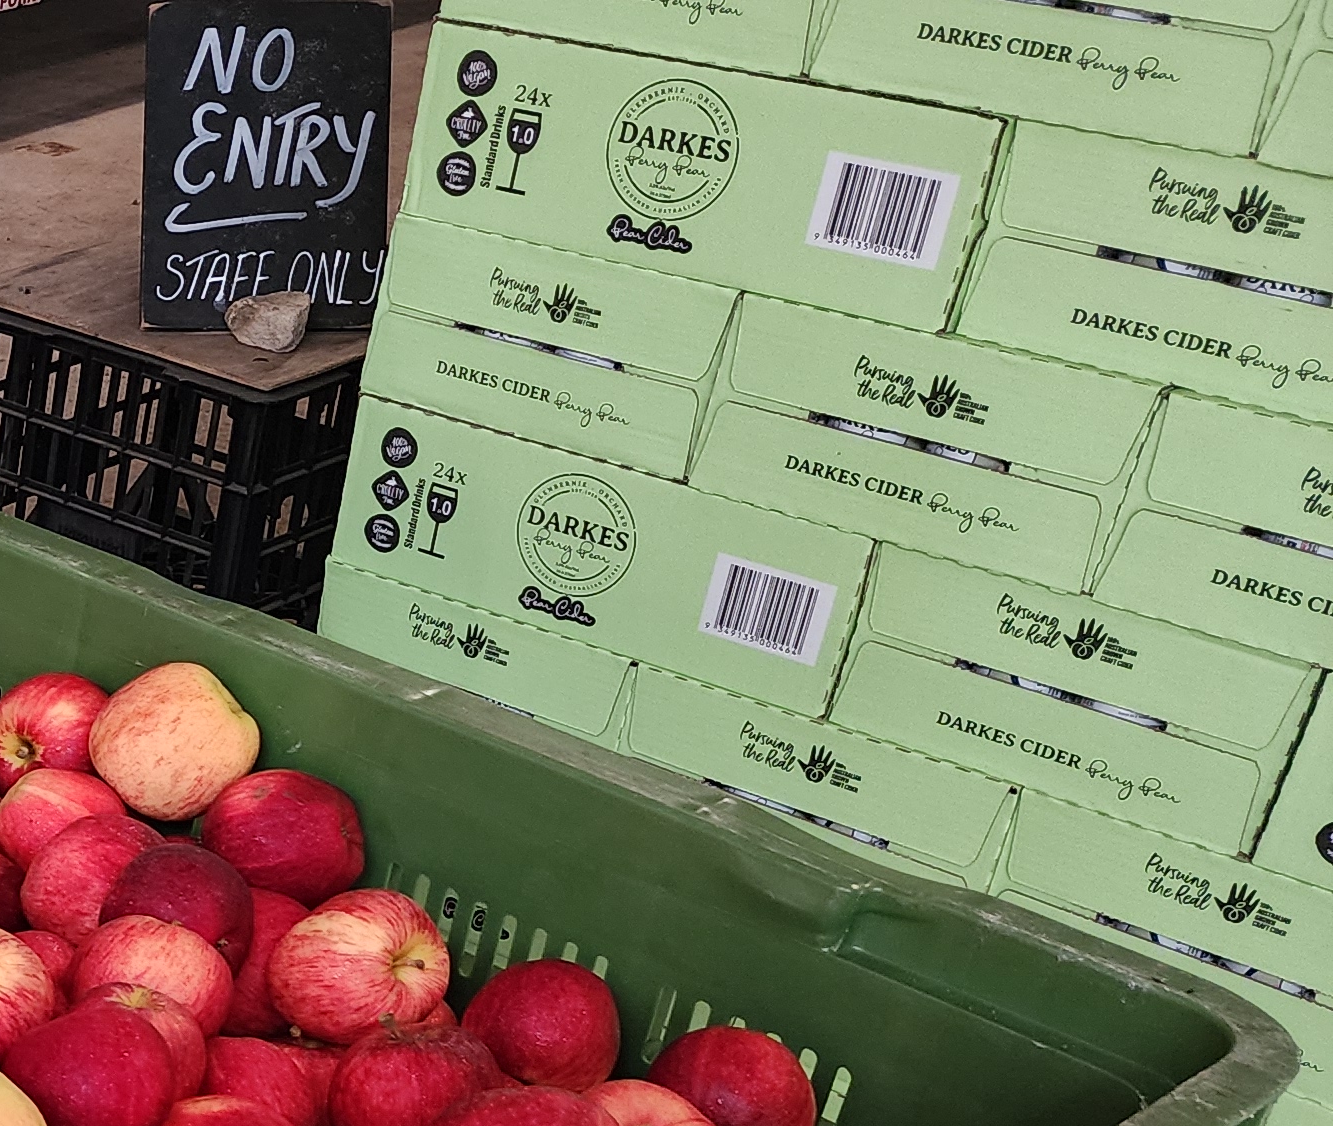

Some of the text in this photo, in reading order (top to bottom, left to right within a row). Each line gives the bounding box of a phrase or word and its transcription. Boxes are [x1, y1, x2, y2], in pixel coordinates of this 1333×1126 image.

[651, 0, 702, 25] erry
[183, 26, 295, 94] NO
[917, 22, 1180, 90] DARKES CIDER Perry Pear
[462, 69, 491, 89] Vegan
[514, 85, 553, 107] 24x
[698, 93, 729, 134] ORCHARD
[480, 105, 507, 188] Standard Drinks
[511, 125, 534, 144] 1.0
[618, 121, 731, 162] DARKES
[173, 101, 376, 208] ENTRY
[625, 146, 710, 184] Perry Pear
[1148, 166, 1218, 205] Pursuing
[1151, 197, 1221, 225] the Real
[611, 218, 688, 250] Pear Cider
[156, 249, 384, 305] STAFF ONLY
[489, 267, 540, 301] Pursuing
[493, 290, 541, 316] the Real
[1070, 308, 1333, 388] DARKES CIDER Perry Pea
[853, 354, 914, 393] Pursuing
[436, 360, 631, 427] DARKES CIDER Perry Pear
[857, 380, 917, 409] the Real
[386, 444, 412, 461] Vegan
[433, 462, 468, 485] 24x
[431, 497, 452, 516] 1.0
[599, 489, 628, 527] ORCHARD
[785, 454, 1020, 533] DARKES CIDER Perry Pear
[1304, 493, 1333, 517] the
[404, 478, 426, 549] Standard Drinks
[527, 505, 629, 551] DARKES
[534, 528, 610, 564] Perry Pear
[1210, 568, 1303, 607] DARKES
[409, 603, 453, 637] Pursuing
[521, 589, 592, 623] Pear Cider
[997, 593, 1059, 632] Pursuing
[412, 624, 455, 649] the Real
[999, 618, 1061, 649] the Real
[740, 721, 794, 757] Pursuing
[743, 743, 796, 772] the Real
[936, 711, 1181, 804] DARKES CIDER Perry Pear
[1145, 852, 1210, 893] Pursuing
[1148, 877, 1212, 911] the Real
